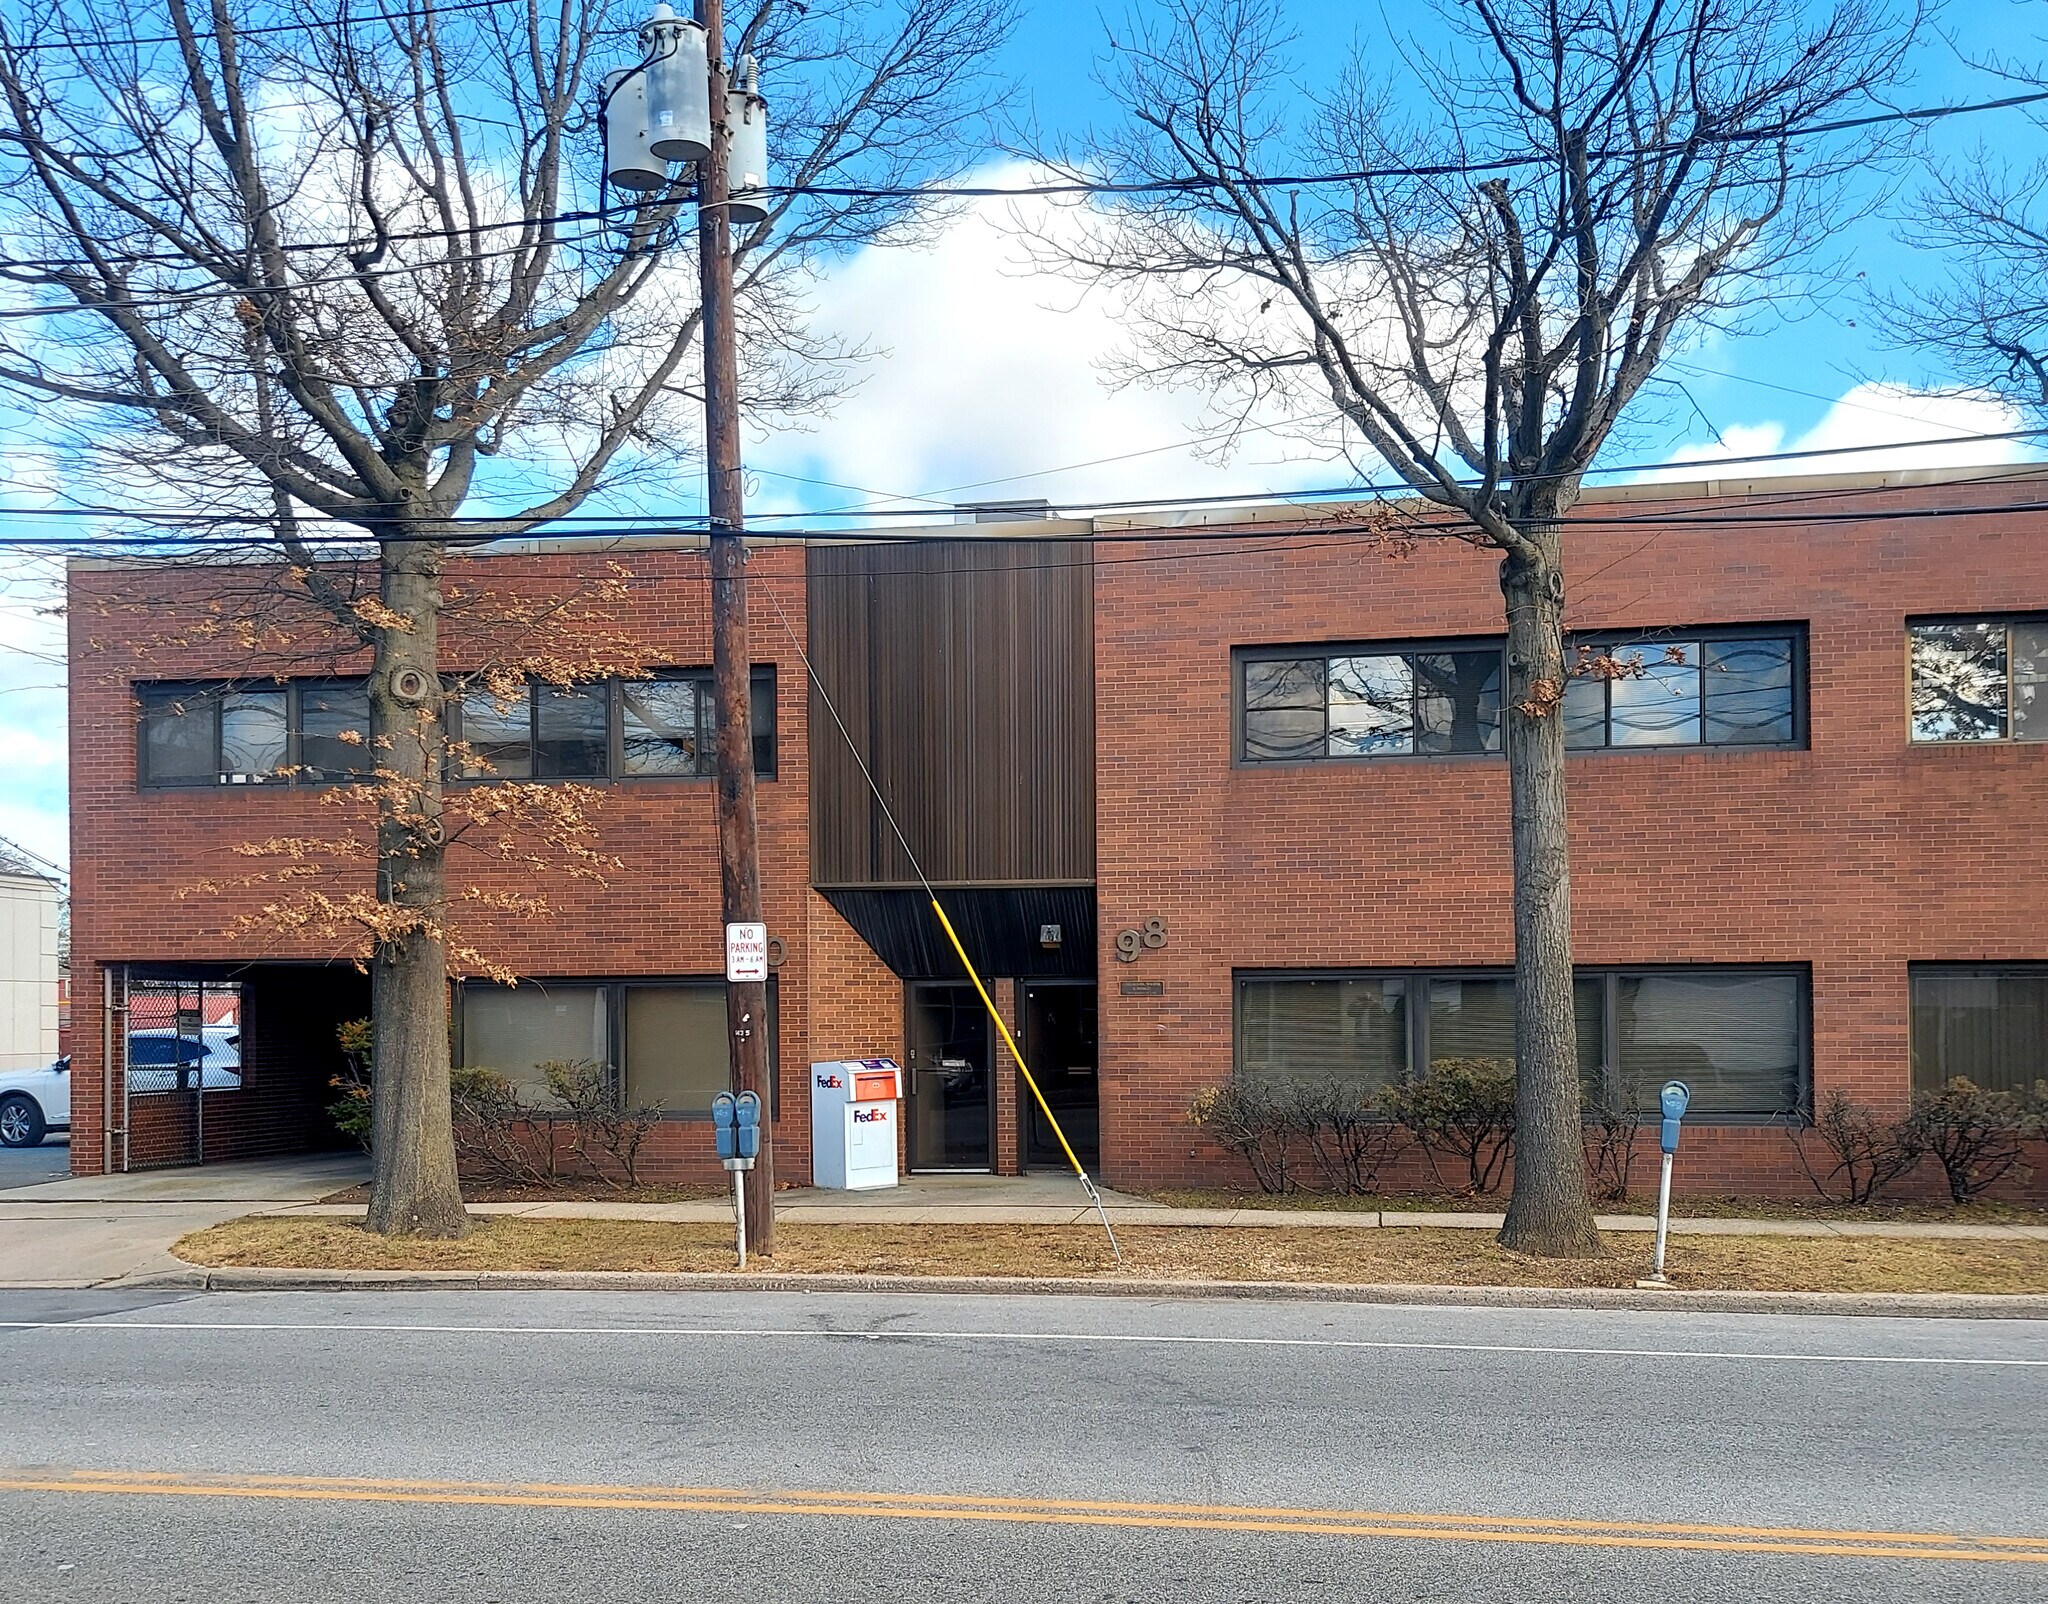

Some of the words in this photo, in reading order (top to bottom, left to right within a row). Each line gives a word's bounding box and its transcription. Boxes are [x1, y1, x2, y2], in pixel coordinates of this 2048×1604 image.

[739, 929, 754, 940] NO
[1117, 916, 1168, 962] 98
[730, 942, 764, 954] PARKING
[816, 1075, 843, 1089] FedEx
[854, 1109, 887, 1123] FedEx
